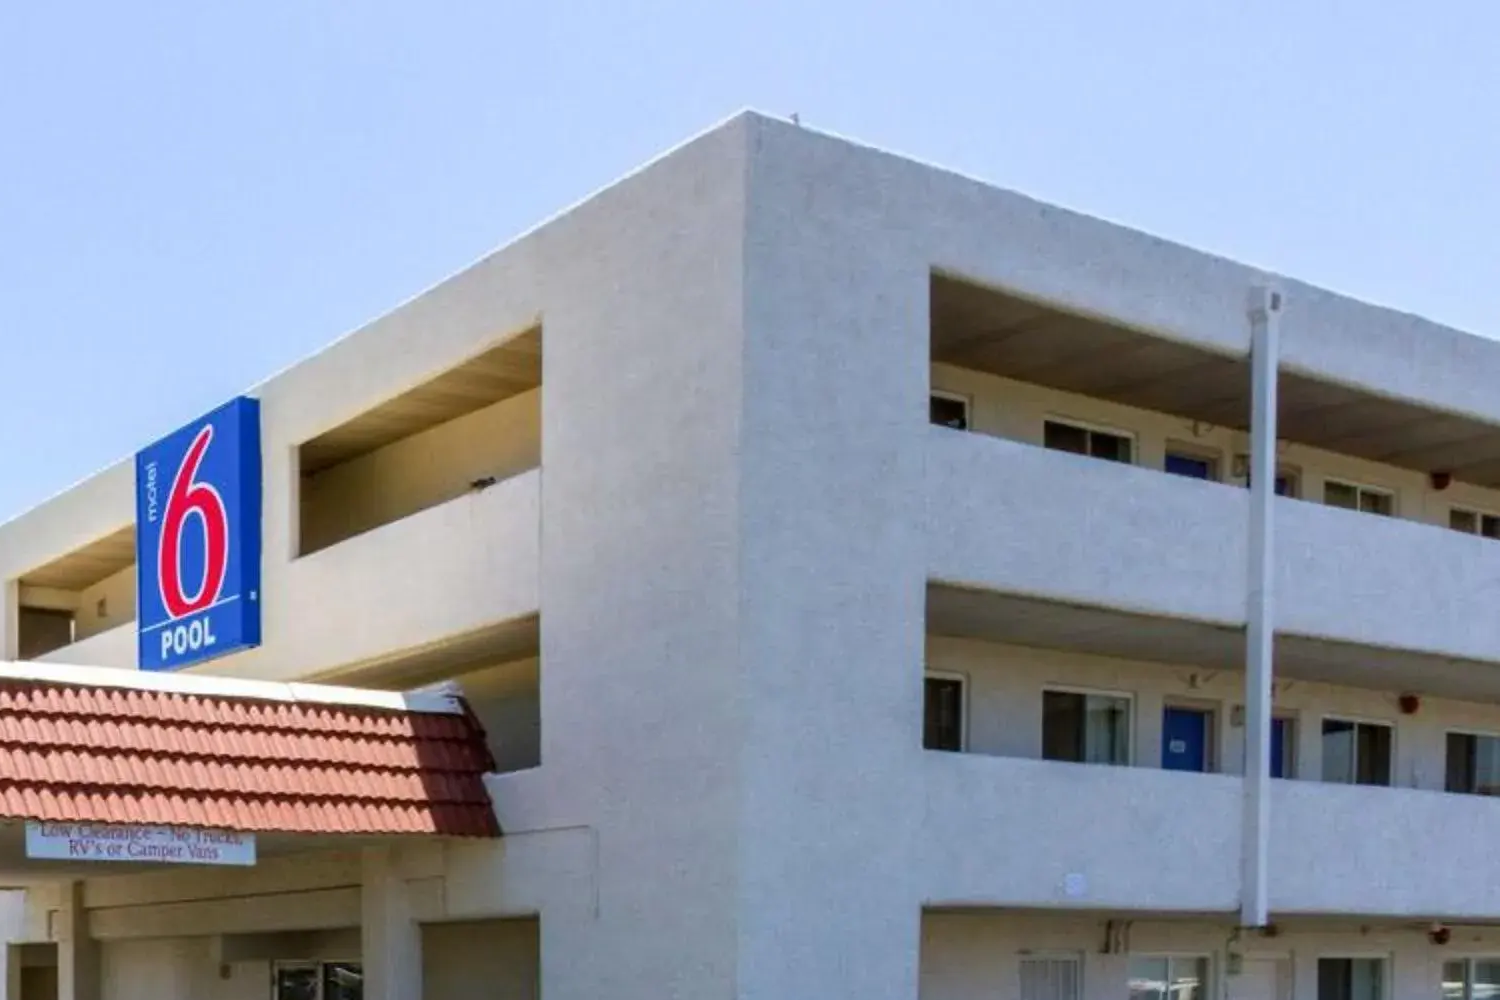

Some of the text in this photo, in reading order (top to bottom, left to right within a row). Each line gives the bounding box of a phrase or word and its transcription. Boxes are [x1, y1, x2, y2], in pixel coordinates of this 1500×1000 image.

[146, 462, 157, 522] motel
[157, 423, 229, 621] 6
[161, 616, 216, 661] POOL
[40, 821, 71, 838] Low
[172, 827, 190, 841] No
[68, 839, 220, 861] RV's or Camper Vans
